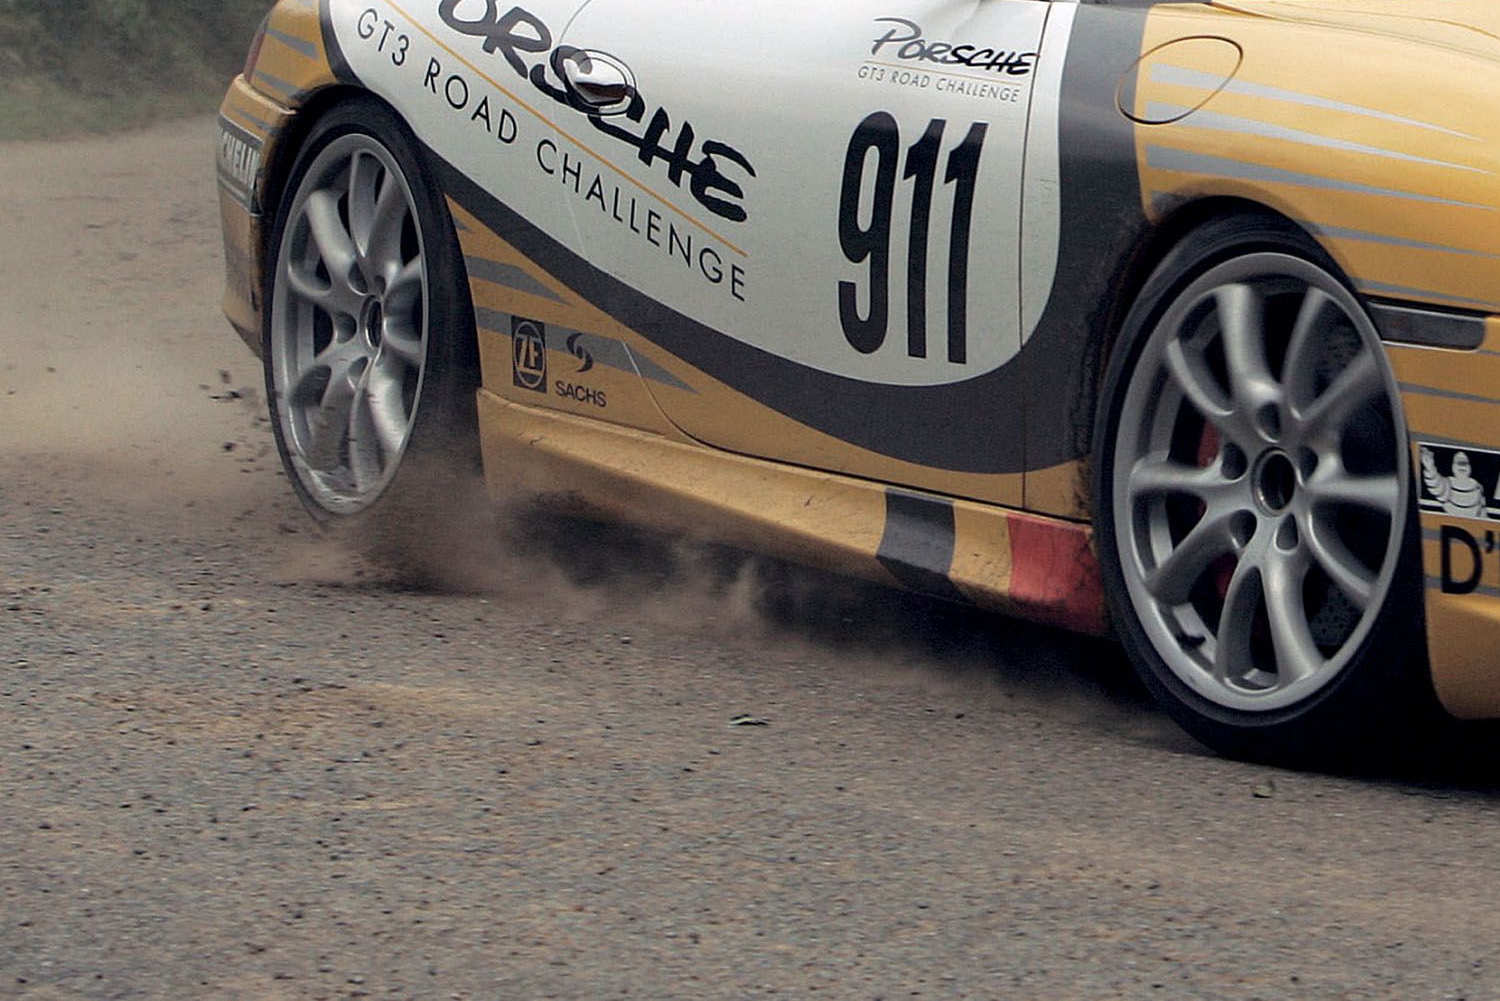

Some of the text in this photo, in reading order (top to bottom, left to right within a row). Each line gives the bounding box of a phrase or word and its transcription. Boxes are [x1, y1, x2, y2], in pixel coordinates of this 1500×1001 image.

[871, 17, 1039, 75] PORSCHE
[857, 65, 1020, 103] GT3 ROAD CHALLENGE
[357, 8, 746, 302] GT3 ROAD CHALLENGE
[838, 110, 989, 365] 911
[515, 332, 543, 377] ZF
[555, 381, 607, 408] SACHS
